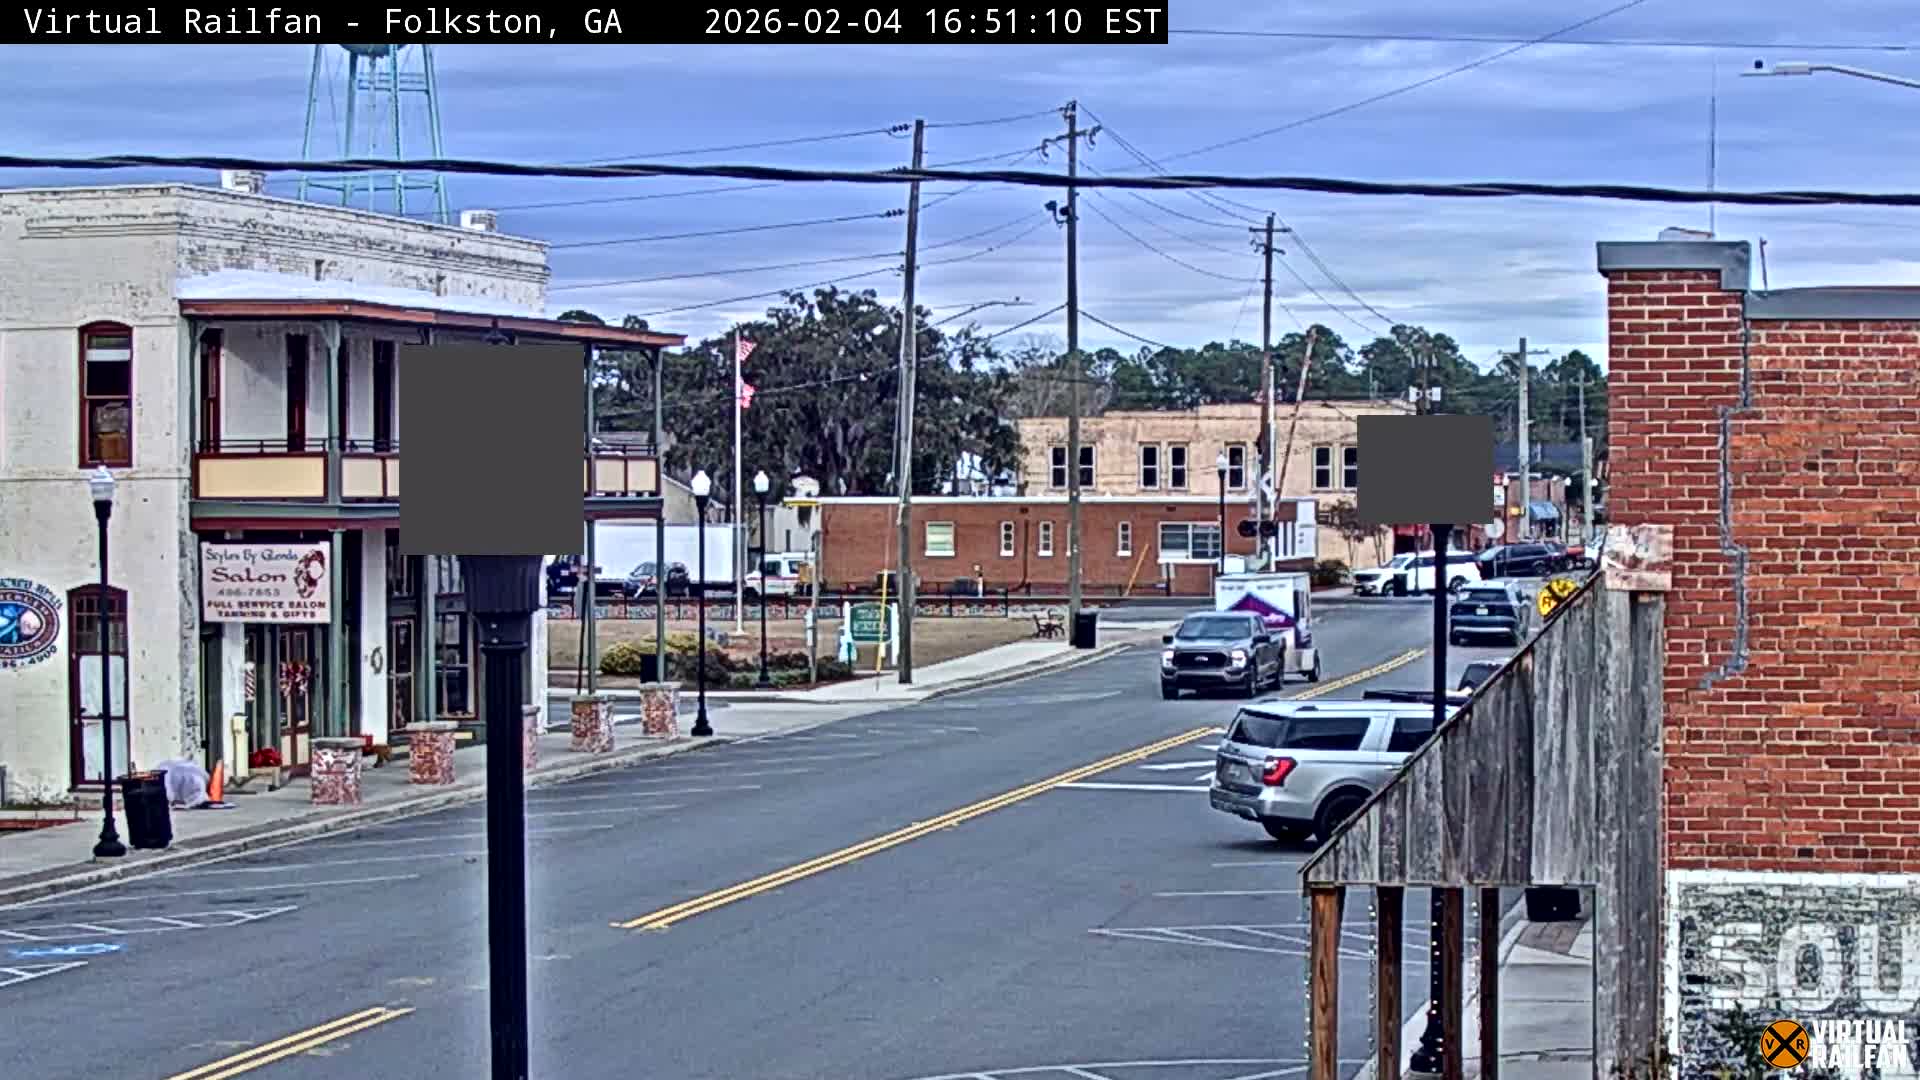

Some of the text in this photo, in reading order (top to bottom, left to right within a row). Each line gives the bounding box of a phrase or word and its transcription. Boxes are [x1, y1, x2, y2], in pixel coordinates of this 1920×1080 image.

[206, 549, 240, 564] Styles
[243, 549, 257, 565] By
[211, 567, 287, 582] Salon
[208, 600, 232, 608] FULL
